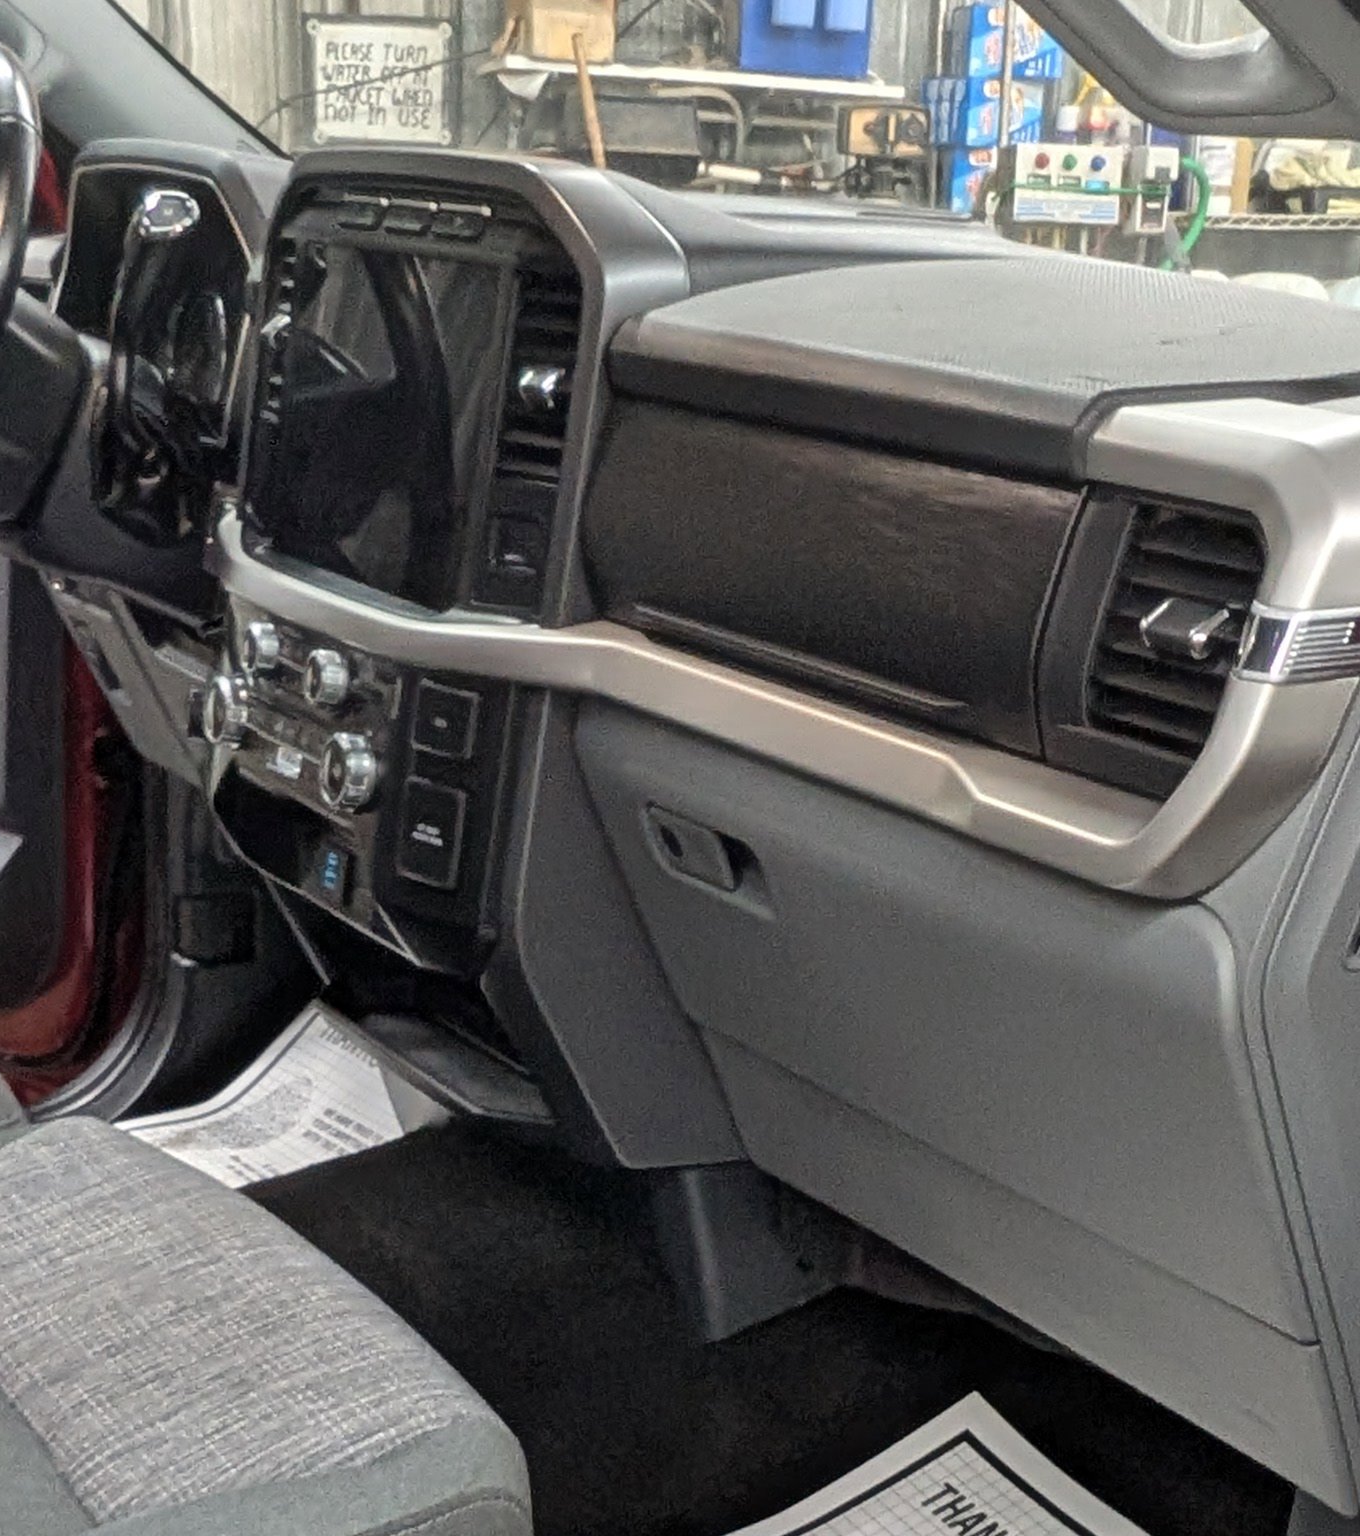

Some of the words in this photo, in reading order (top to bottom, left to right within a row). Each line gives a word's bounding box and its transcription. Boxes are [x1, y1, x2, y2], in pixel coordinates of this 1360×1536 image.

[325, 41, 373, 62] PLEASE
[322, 64, 372, 82] WATER
[324, 84, 384, 105] FAUCET
[398, 108, 430, 129] USE
